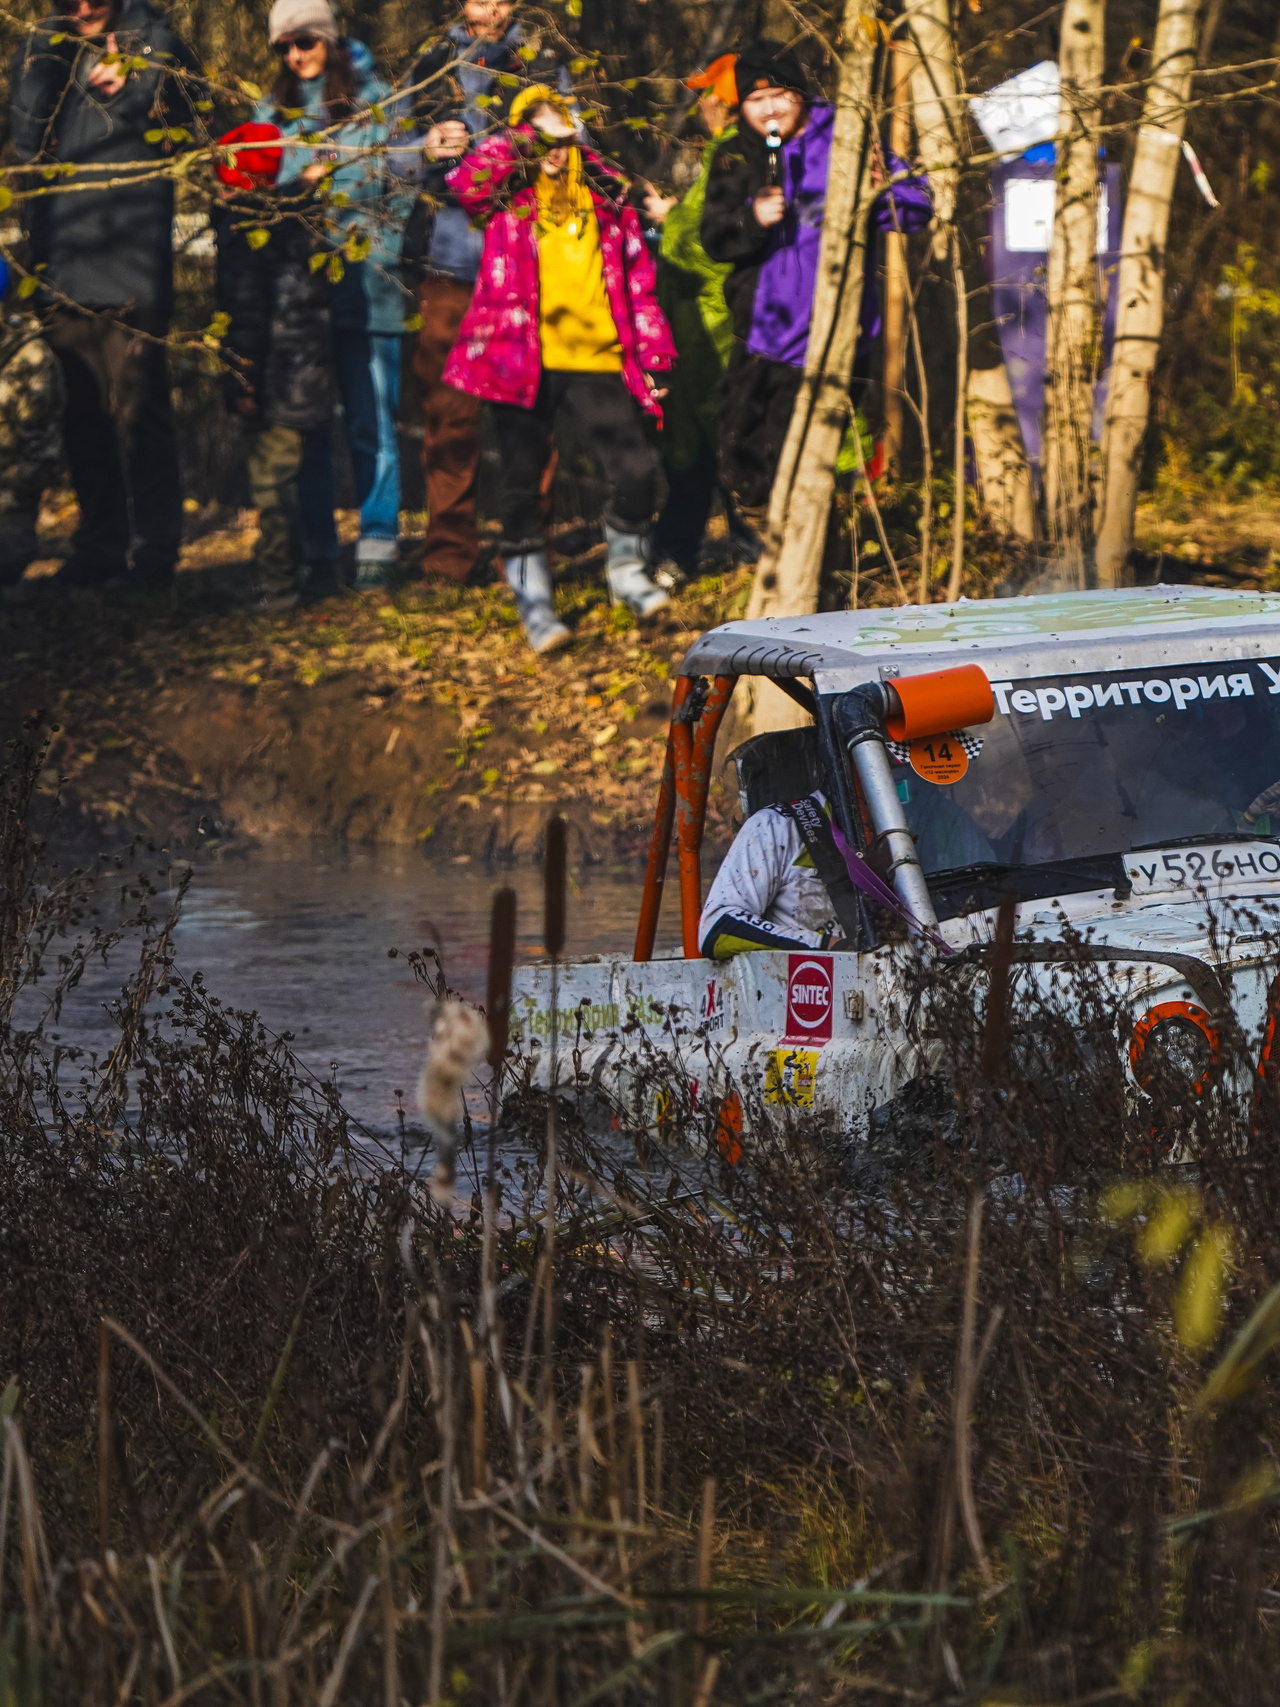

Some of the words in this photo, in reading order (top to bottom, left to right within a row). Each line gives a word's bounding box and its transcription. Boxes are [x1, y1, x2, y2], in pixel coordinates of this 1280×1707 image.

[991, 672, 1256, 720] Территория
[924, 743, 953, 762] 14
[791, 803, 818, 843] Devices
[791, 984, 830, 1006] SINTEC
[700, 1013, 725, 1034] ORT
